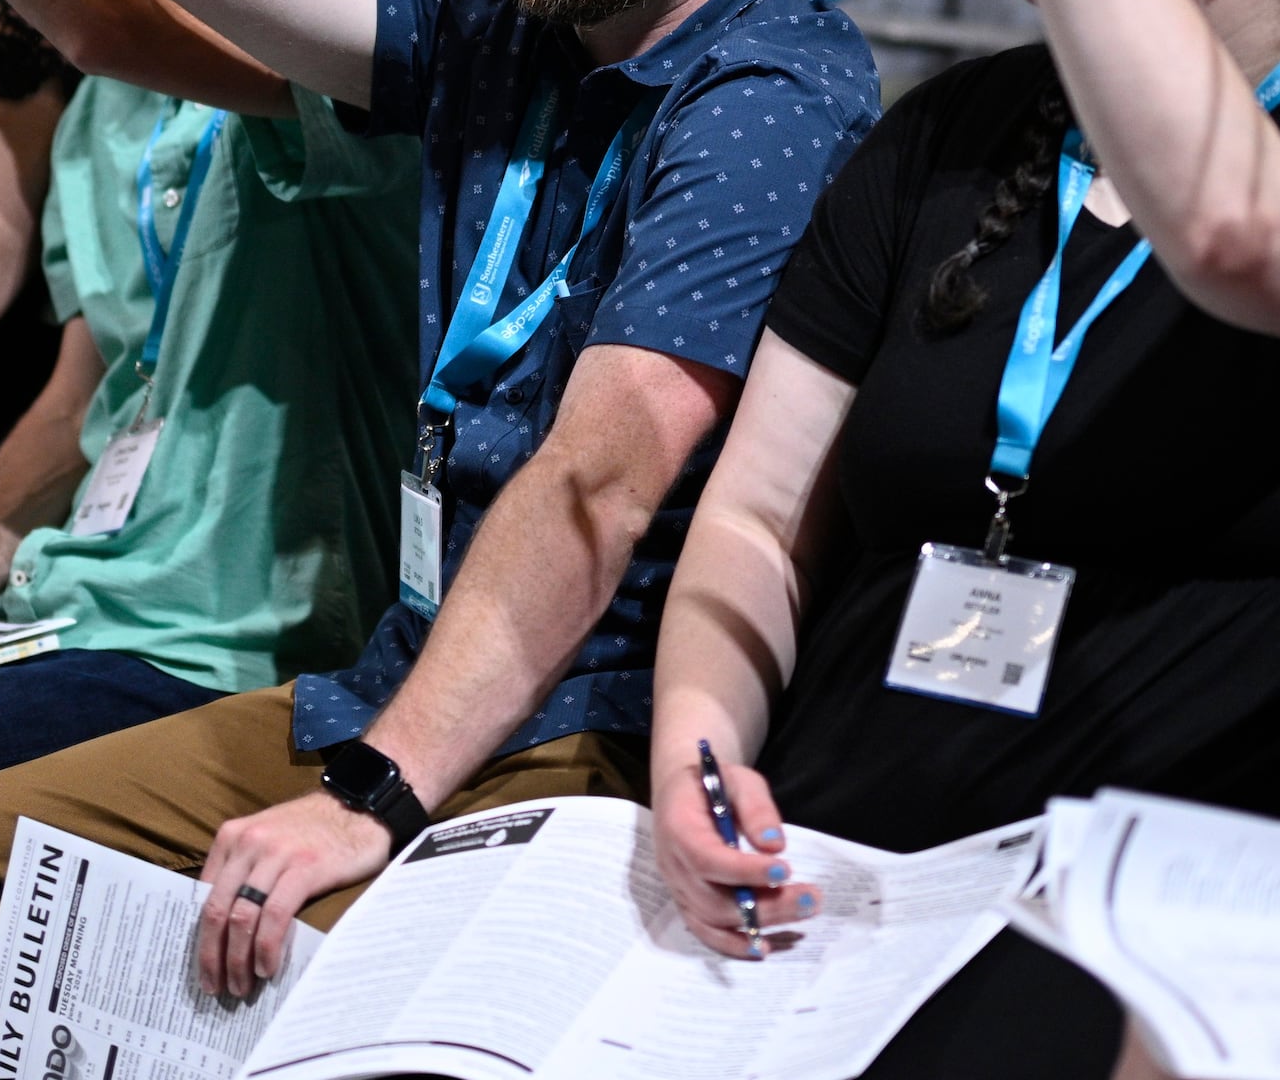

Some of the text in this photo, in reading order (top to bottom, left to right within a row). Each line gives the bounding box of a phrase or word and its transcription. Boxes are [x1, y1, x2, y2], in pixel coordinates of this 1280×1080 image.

[480, 216, 510, 282] Southeastern
[5, 904, 18, 942] BAPTIST
[14, 837, 33, 900] CONVENTION
[8, 843, 63, 1013] BULLETIN
[54, 882, 82, 988] PROPOSED ORDER OF BUSINESS
[59, 915, 87, 1016] TUESDAY MORNING
[67, 1002, 76, 1020] June
[73, 968, 82, 990] 2026
